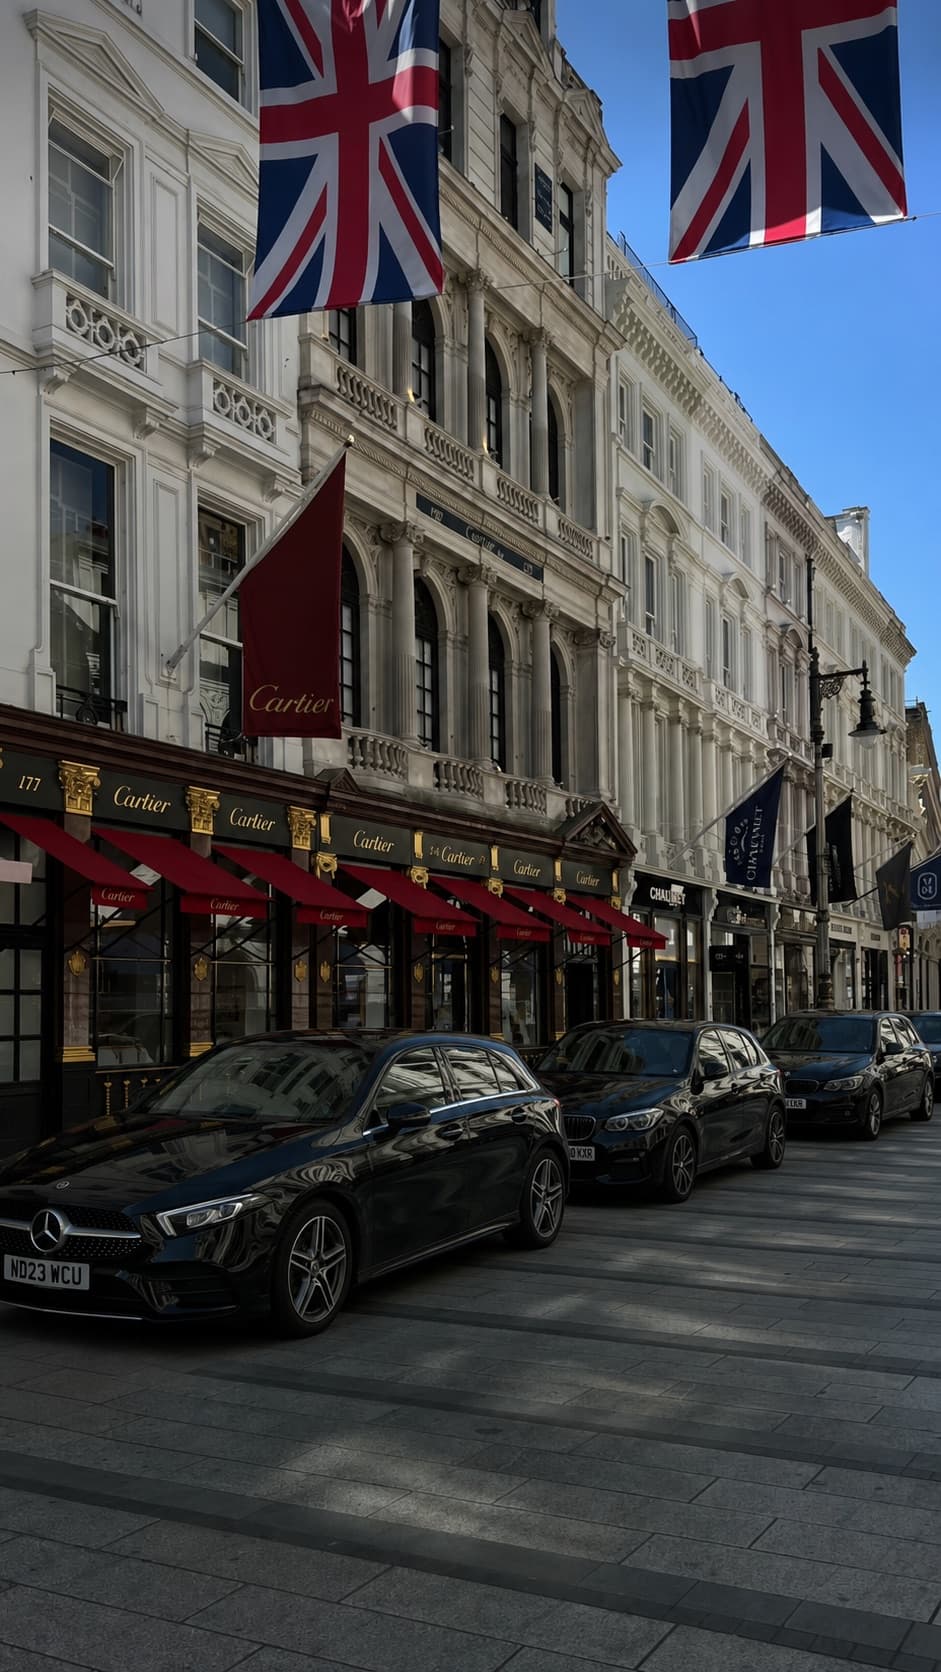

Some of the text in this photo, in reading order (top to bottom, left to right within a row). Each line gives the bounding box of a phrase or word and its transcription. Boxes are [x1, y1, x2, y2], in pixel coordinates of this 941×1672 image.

[249, 684, 335, 714] Cartier
[17, 775, 42, 793] 177
[113, 785, 172, 815] Cartier
[229, 807, 276, 832] Cartier
[352, 830, 396, 855] Cartier
[441, 845, 476, 867] Cartier
[513, 859, 542, 878] Cartier
[576, 870, 602, 888] Cartier
[100, 887, 137, 905] Cartier
[210, 897, 241, 913] Cartier
[320, 909, 344, 923] Cartier
[11, 1257, 83, 1286] ND23 WCU
